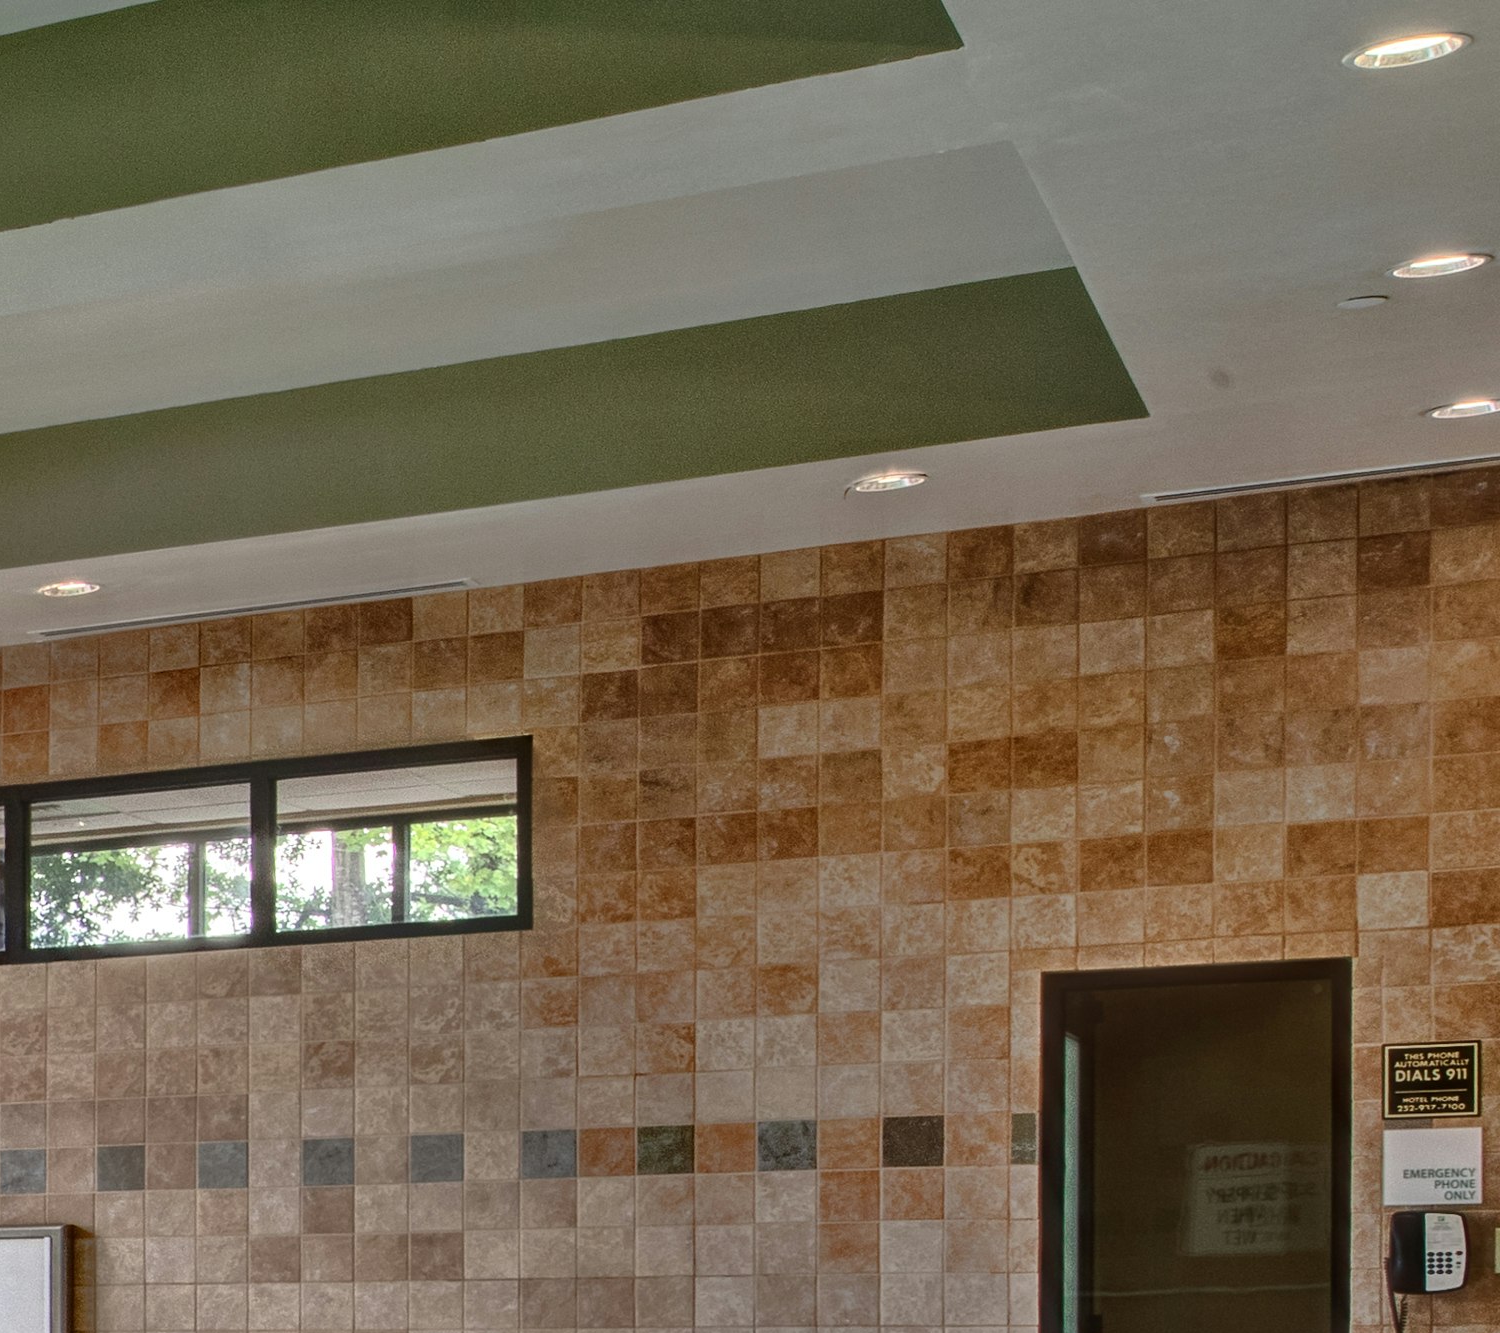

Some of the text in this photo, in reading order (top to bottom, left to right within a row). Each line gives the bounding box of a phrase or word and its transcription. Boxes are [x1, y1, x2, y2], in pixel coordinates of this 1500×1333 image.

[1427, 1051, 1460, 1059] PHONE
[1394, 1059, 1470, 1068] AUTOMATICALLY
[1395, 1068, 1468, 1082] DIALS 911
[1403, 1168, 1476, 1179] EMERGENCY
[1434, 1179, 1476, 1189] PHONE
[1444, 1190, 1476, 1200] ONLY
